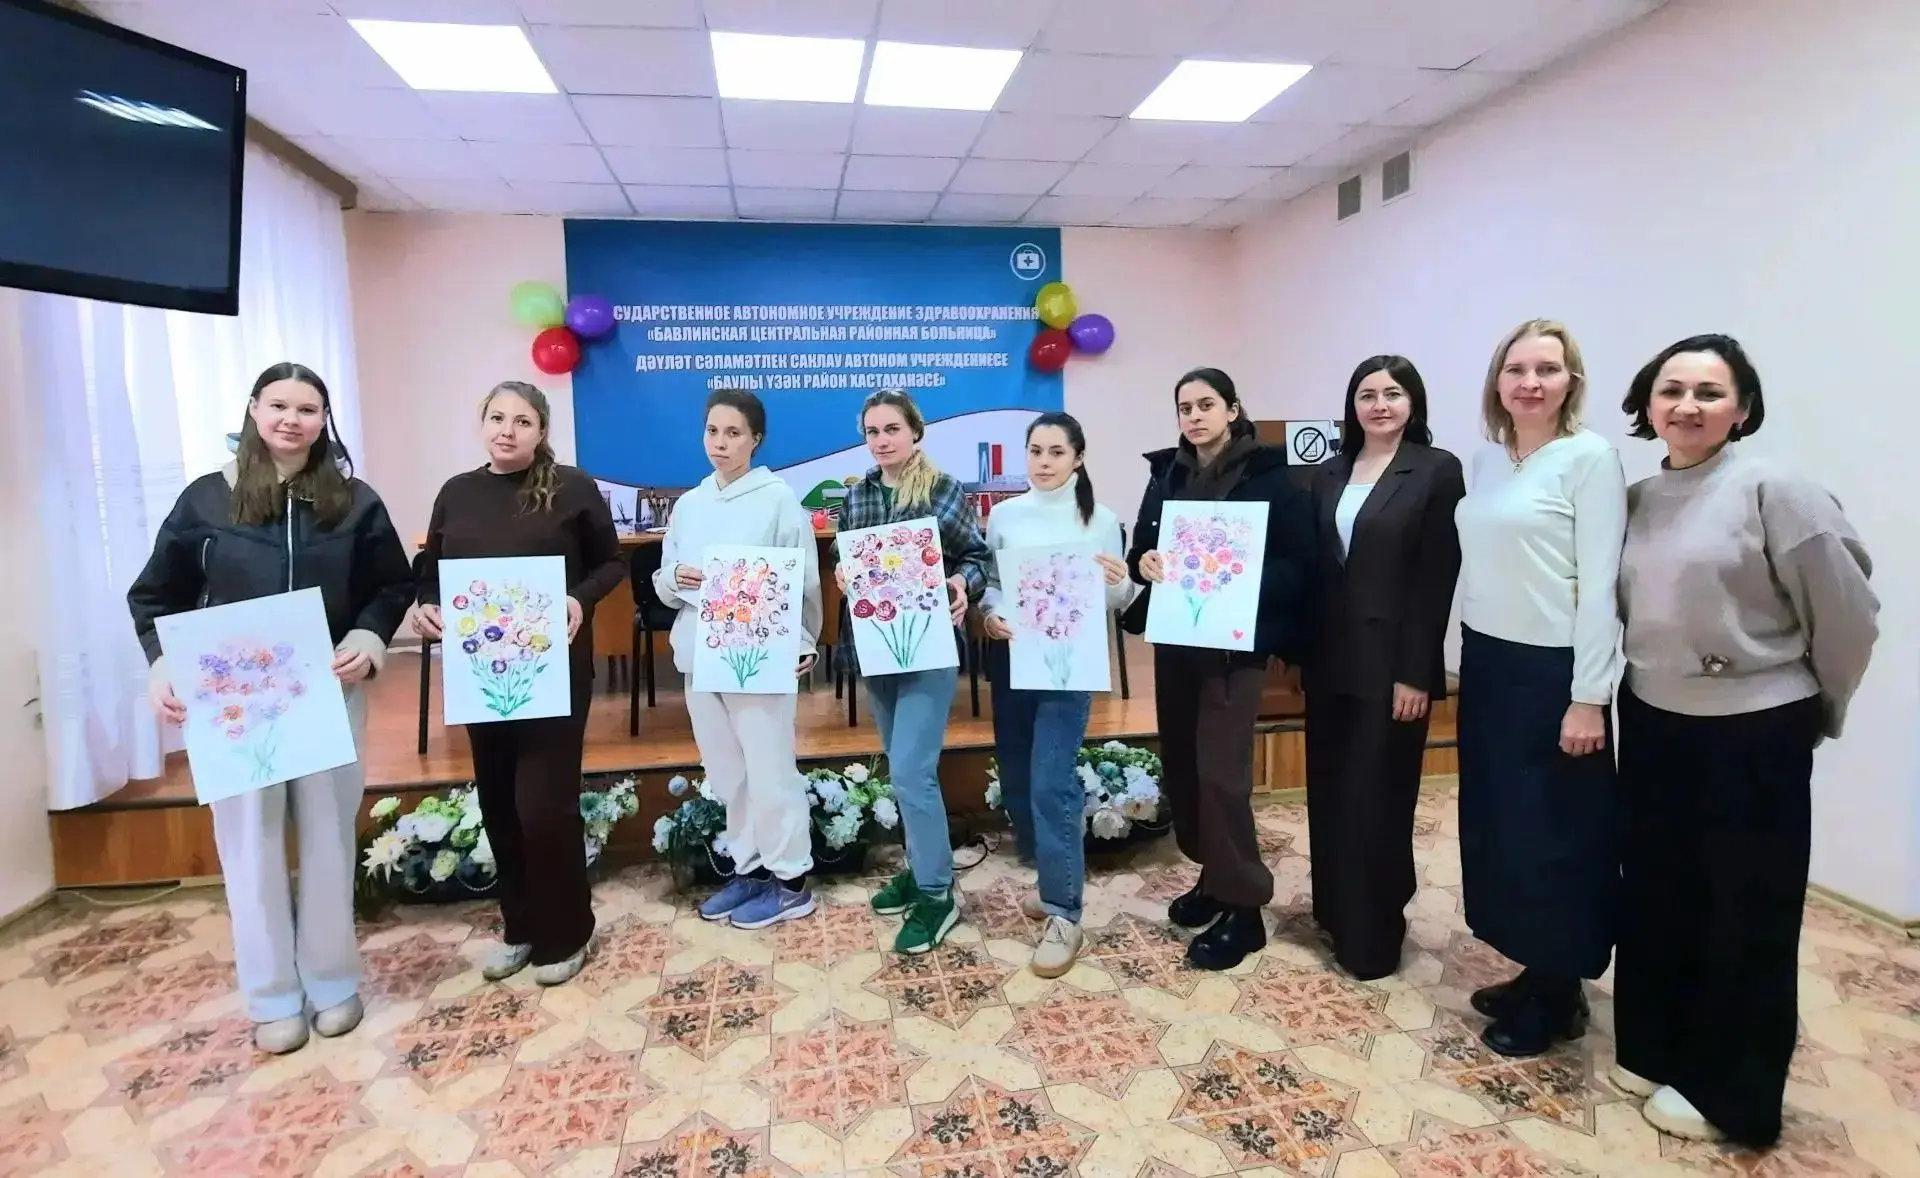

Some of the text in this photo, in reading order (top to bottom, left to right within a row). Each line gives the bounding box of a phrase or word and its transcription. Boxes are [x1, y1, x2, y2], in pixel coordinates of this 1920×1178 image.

[613, 305, 1039, 322] СУДАРСТВЕННОЕ АВТОНОМНОЕ УЧРЕЖДЕНИЕ ЗДРАВООХРАНЕНИЯ
[647, 324, 996, 343] «БАВЛИНСКАЯ ЦЕНТРАЛЬНАЯ РАЙОННАЯ БОЛЬНИЦА»
[695, 354, 787, 369] СӘЛАМӘТЛЕК
[790, 353, 842, 368] САКЛАУ
[844, 353, 908, 368] АВТОНОМ
[910, 352, 1008, 369] УЧРЕЖДЕНИЕСЕ
[707, 374, 763, 390] «БАУЛЫ
[804, 372, 847, 389] РАЙОН
[850, 373, 946, 388] ХАСТАХАНӘСЕ»
